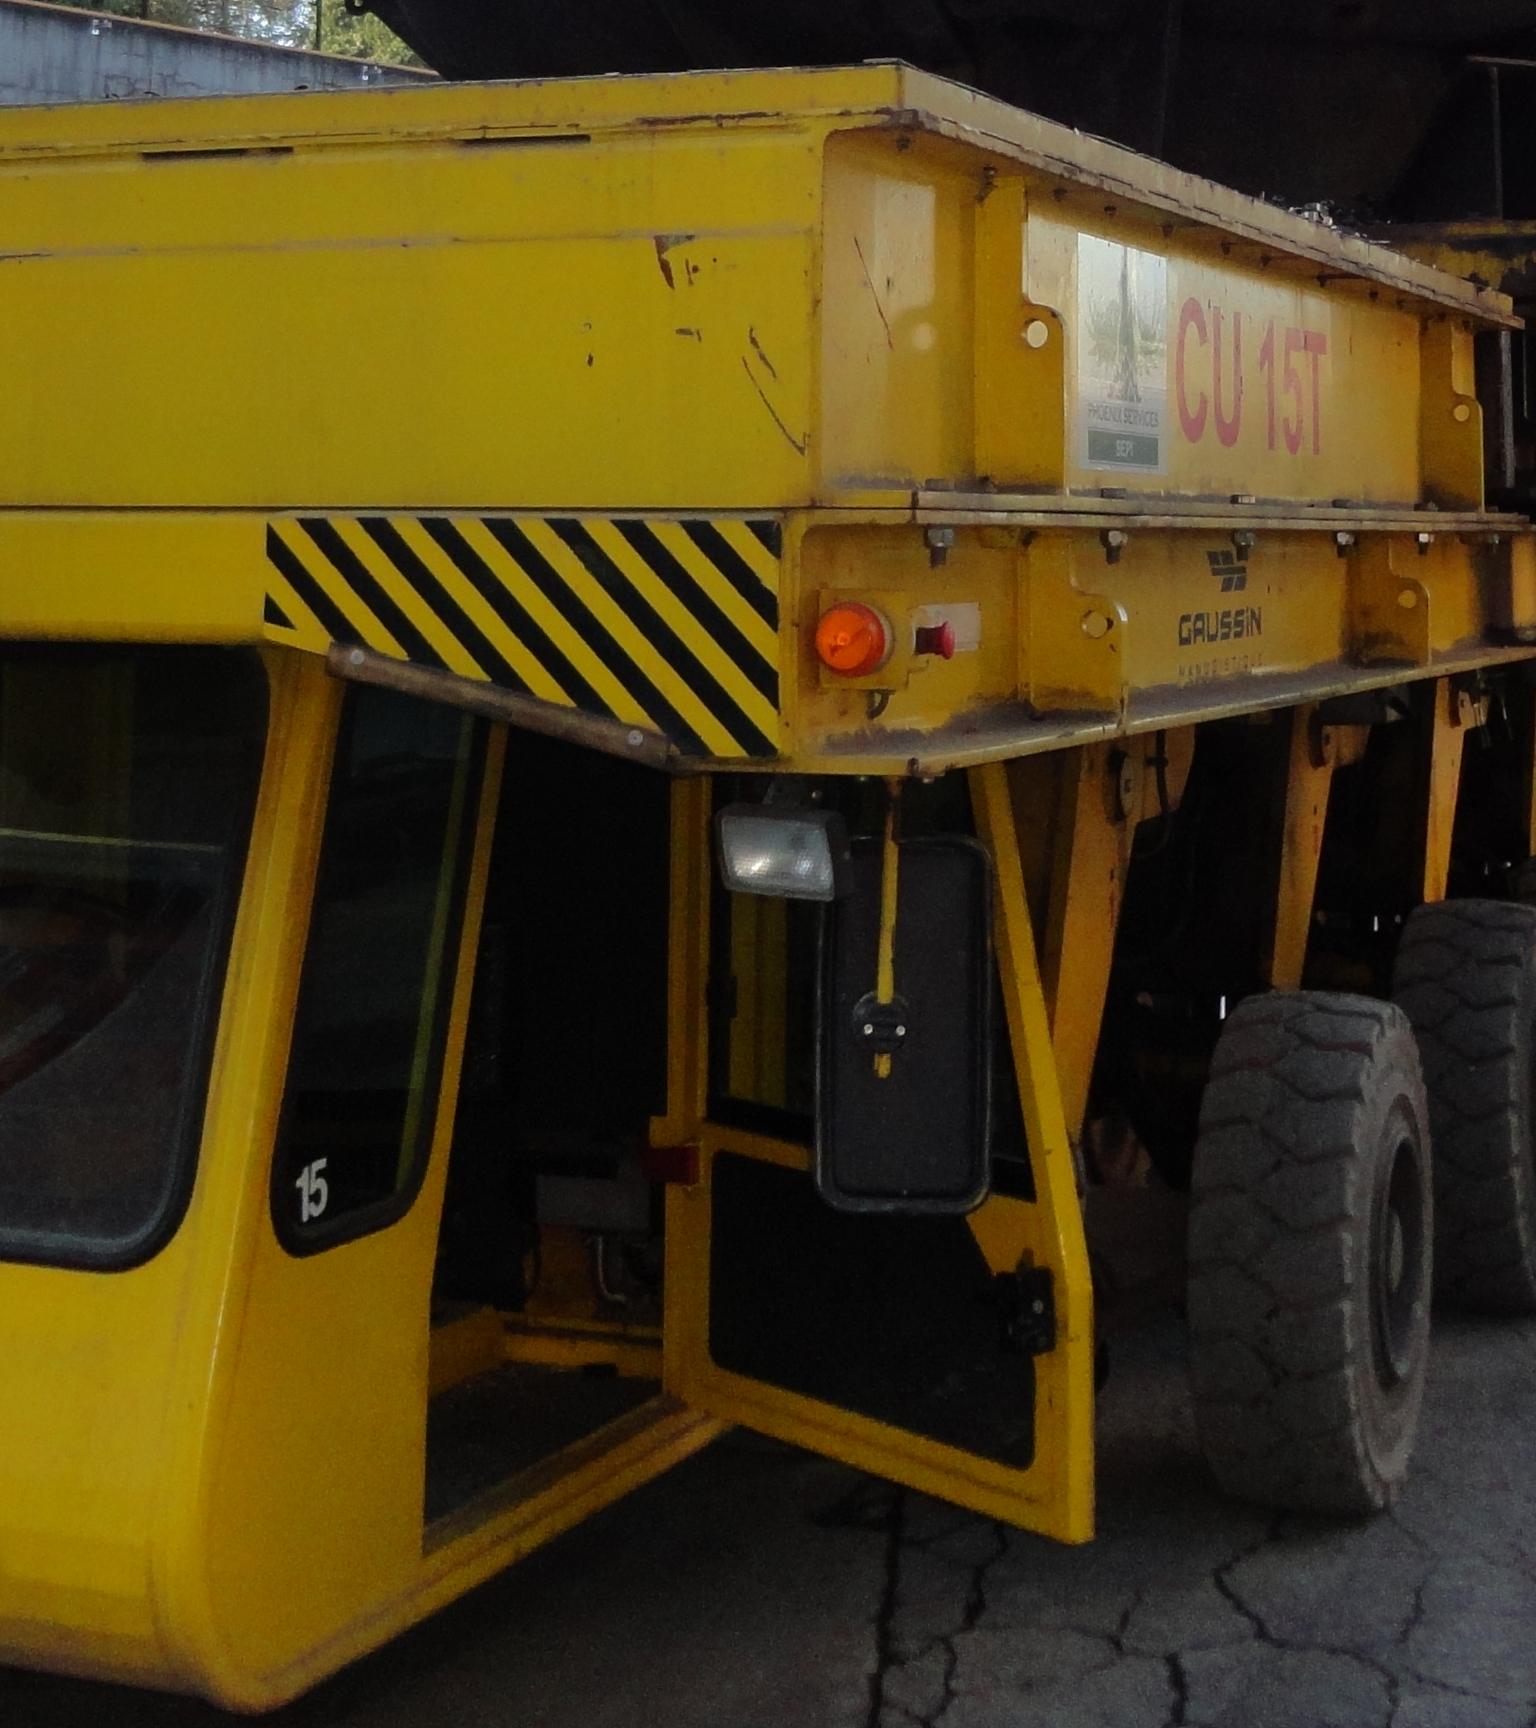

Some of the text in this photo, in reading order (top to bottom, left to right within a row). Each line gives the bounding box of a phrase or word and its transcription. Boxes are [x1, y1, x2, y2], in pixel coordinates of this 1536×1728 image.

[1175, 296, 1328, 456] CU 15T
[295, 1157, 328, 1223] 15
